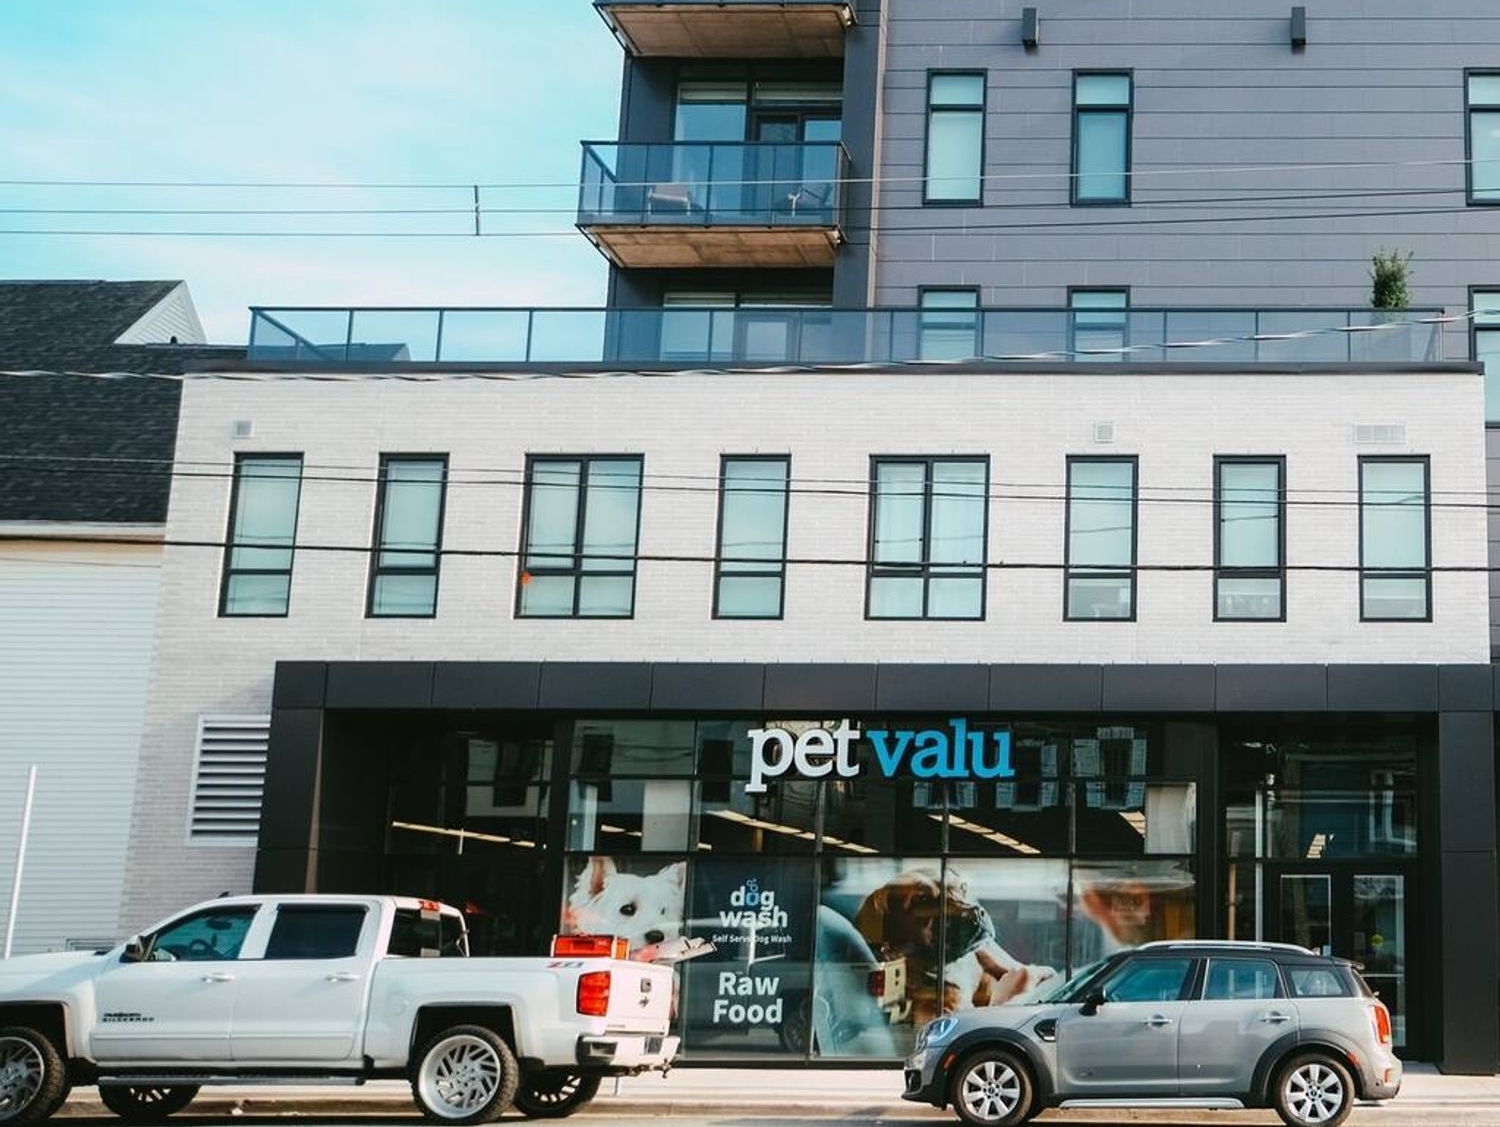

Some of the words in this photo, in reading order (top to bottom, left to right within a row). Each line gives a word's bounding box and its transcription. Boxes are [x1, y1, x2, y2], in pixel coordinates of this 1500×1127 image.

[745, 719, 861, 793] pet
[866, 718, 1015, 778] valu
[730, 885, 775, 911] dog
[719, 905, 788, 928] wash
[712, 934, 728, 943] Self
[770, 934, 792, 943] Wash
[719, 971, 780, 996] Raw
[713, 998, 783, 1024] Food
